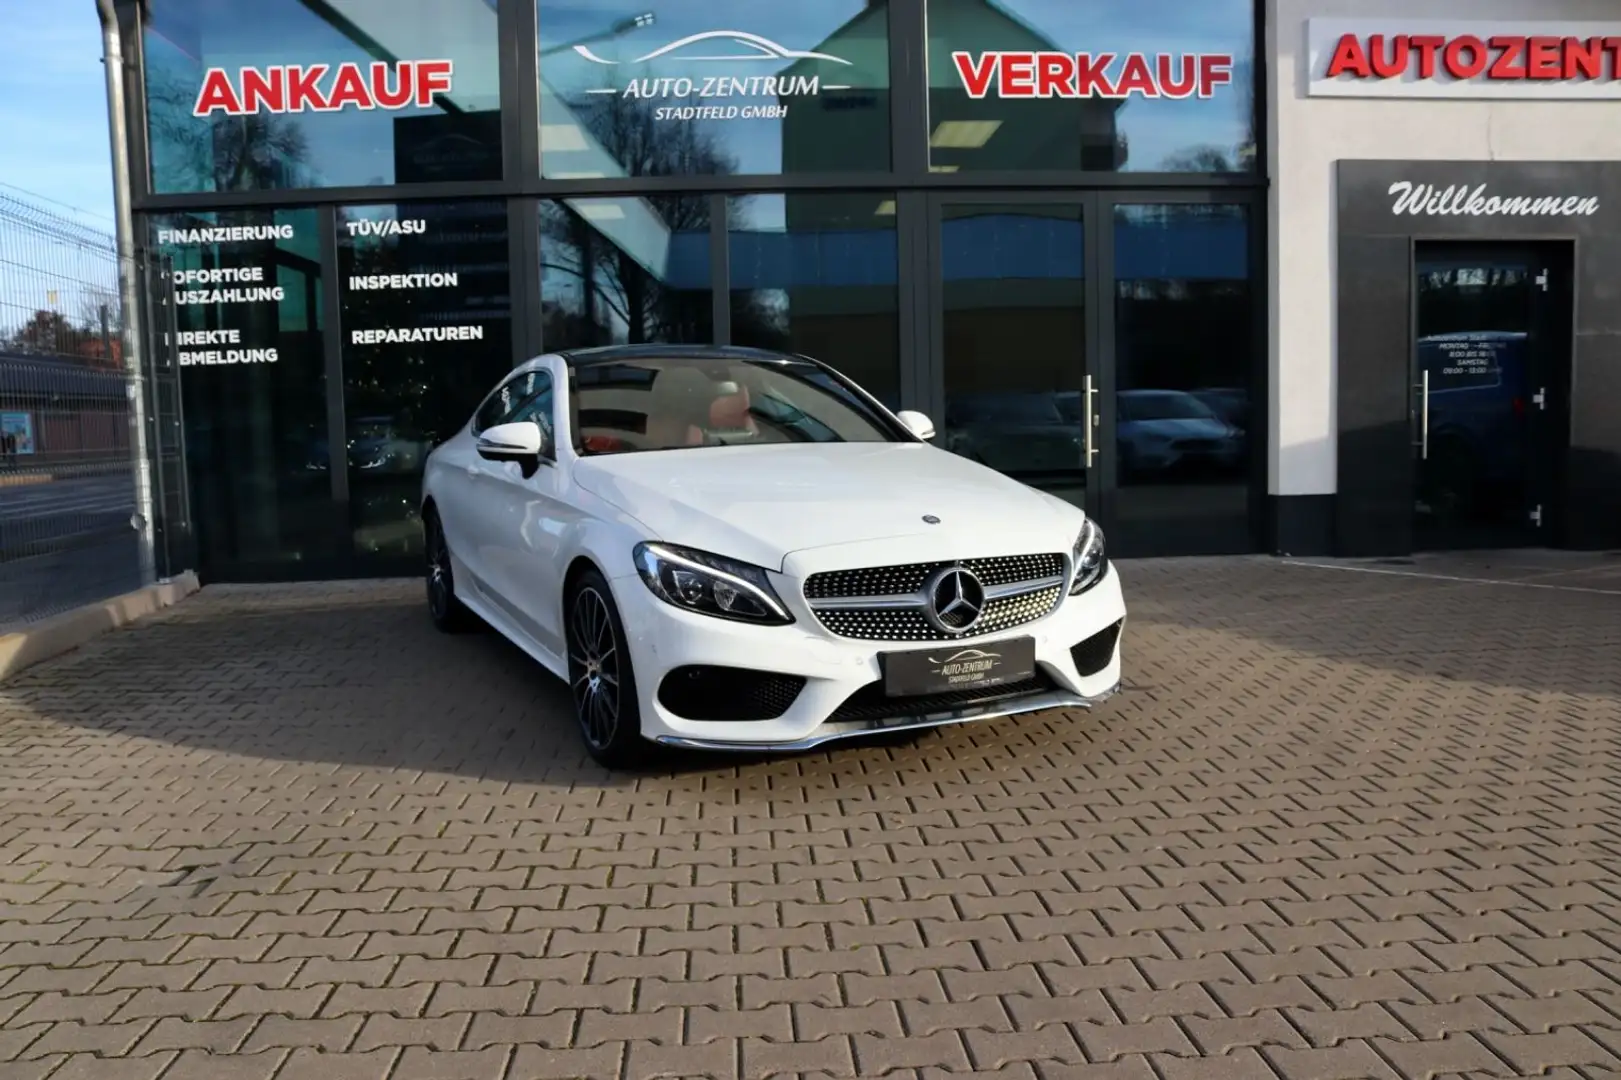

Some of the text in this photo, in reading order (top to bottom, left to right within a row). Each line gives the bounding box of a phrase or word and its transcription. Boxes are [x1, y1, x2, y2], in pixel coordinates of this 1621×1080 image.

[952, 51, 1233, 99] VERKAUF
[193, 59, 455, 117] ANKAUF
[622, 75, 819, 99] AUTO-ZENTRUM
[655, 105, 788, 121] STADTFELD GMBH
[1388, 181, 1600, 216] Willkommen
[157, 224, 294, 244] FINANZIERUNG
[346, 219, 426, 238] TÜV/ASU
[349, 272, 458, 291] INSPEKTION
[163, 287, 285, 305] USZAHLUNG
[352, 325, 483, 344] REPARATUREN
[166, 348, 278, 366] BMELDUNG
[942, 659, 993, 676] AUTO-ZENTRUM
